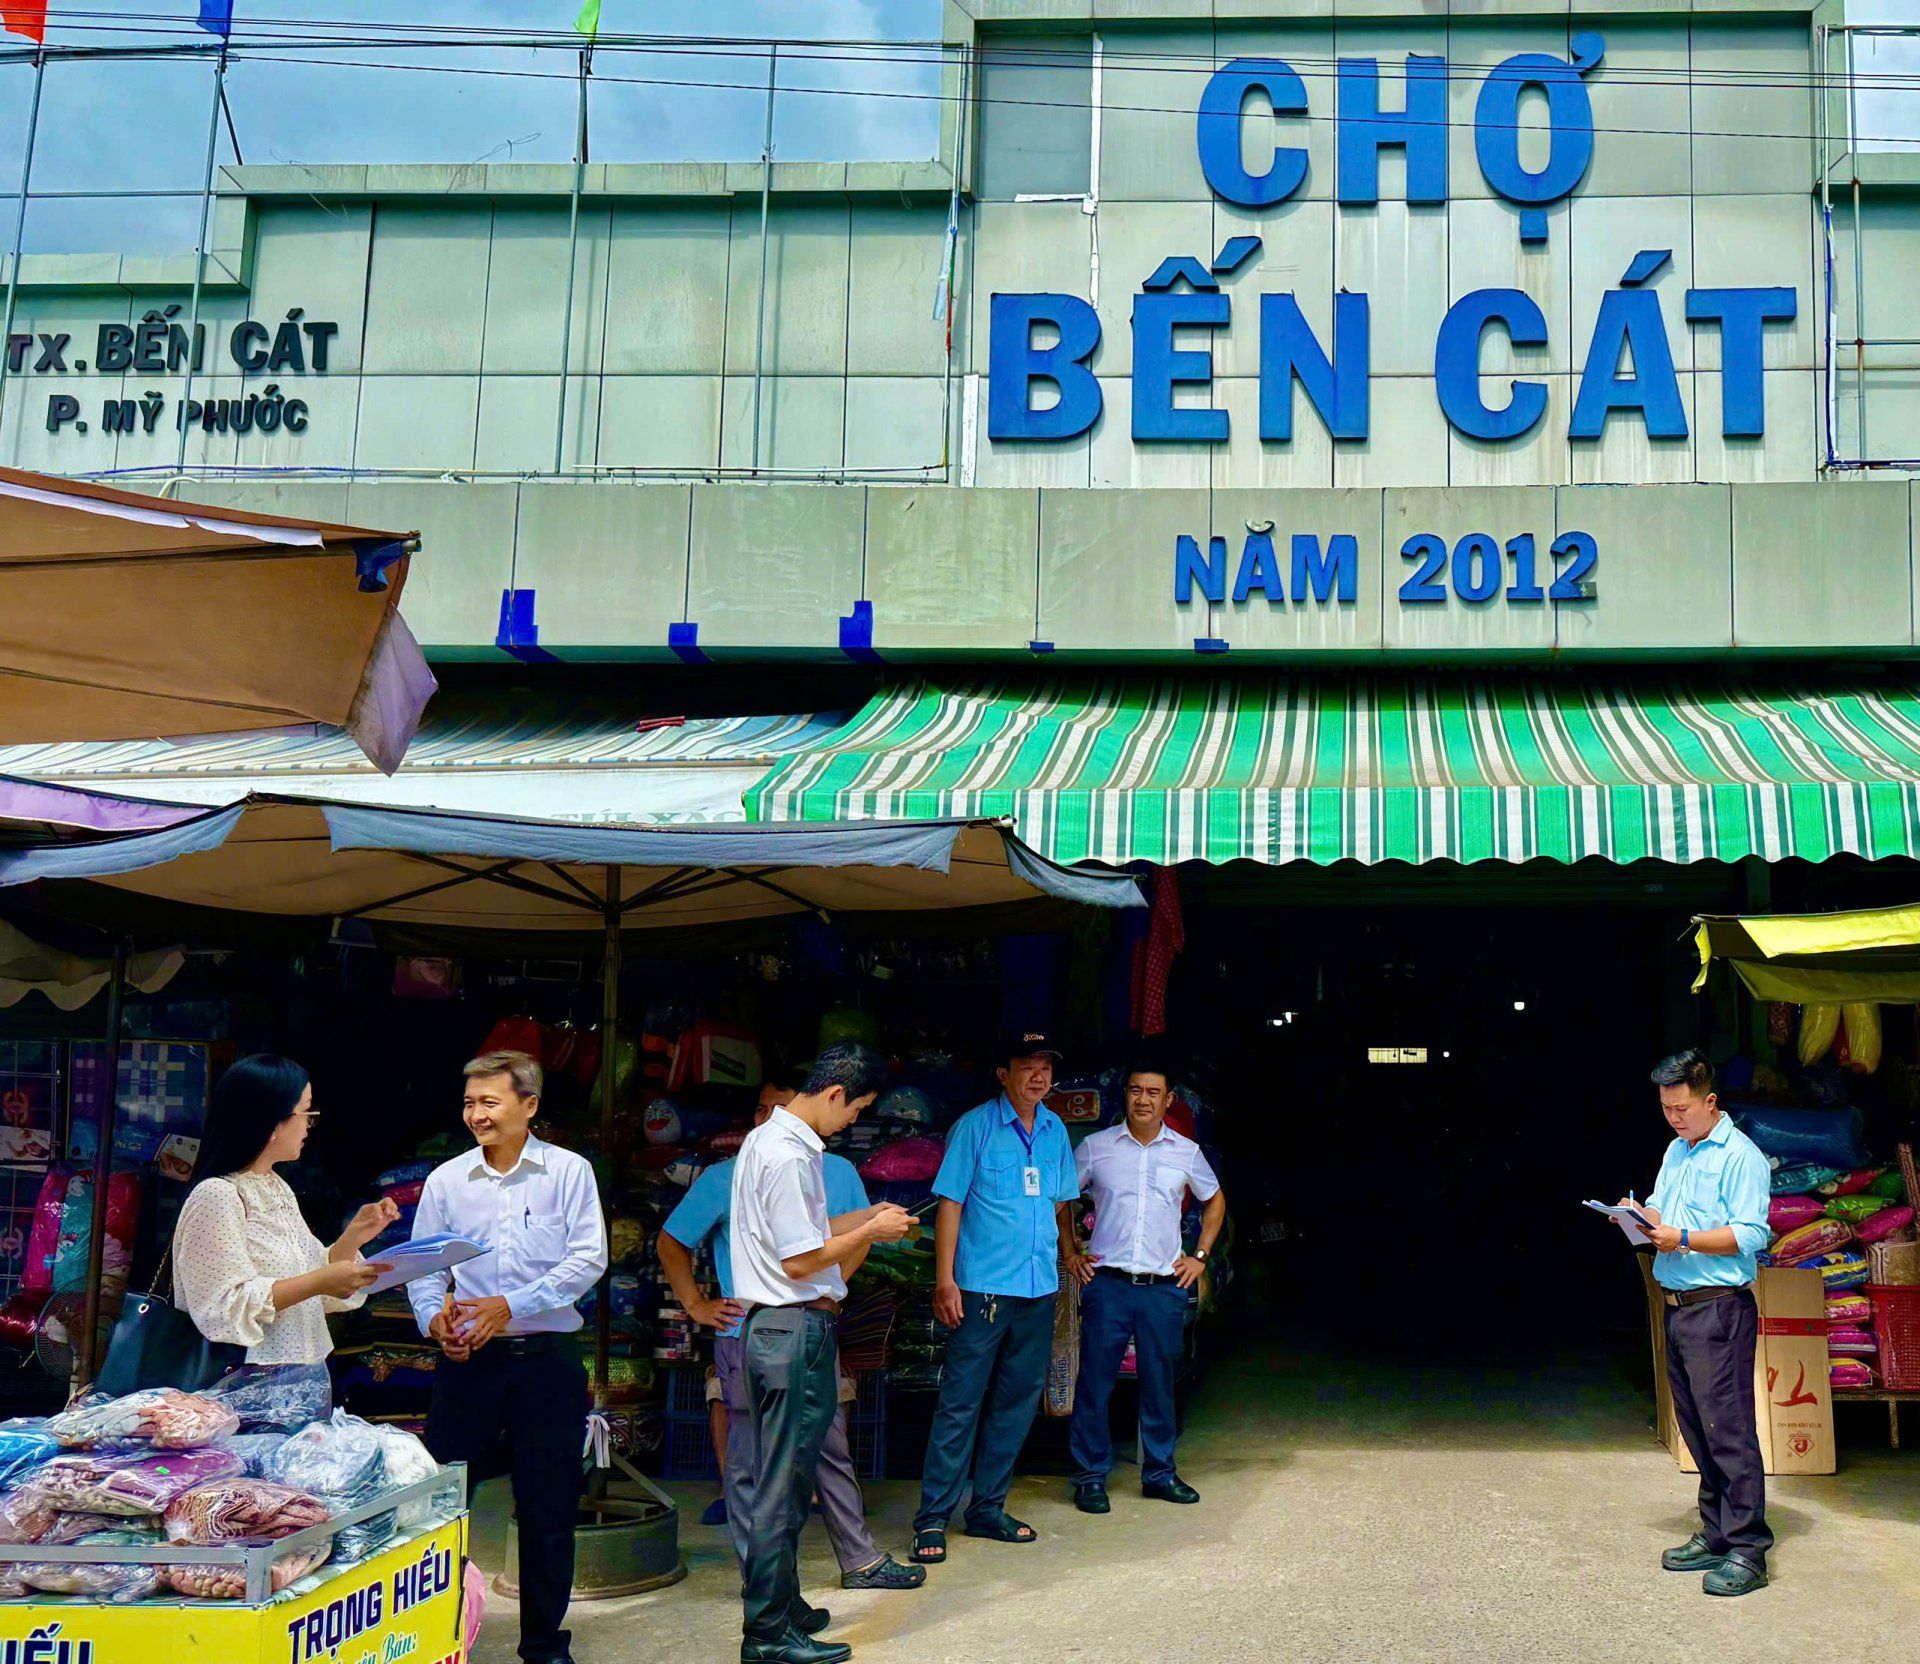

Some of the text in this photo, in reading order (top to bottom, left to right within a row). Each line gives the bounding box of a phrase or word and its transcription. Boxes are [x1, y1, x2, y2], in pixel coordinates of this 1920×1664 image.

[1197, 30, 1606, 243] CHỢ
[7, 304, 339, 372] TX. BẾN CÁT
[987, 236, 1797, 443] BẾN CÁT
[46, 384, 309, 433] P. MỸ PHƯỚC
[1174, 519, 1599, 603] NĂM 2012
[287, 1541, 452, 1664] TRỌNG HIẾU
